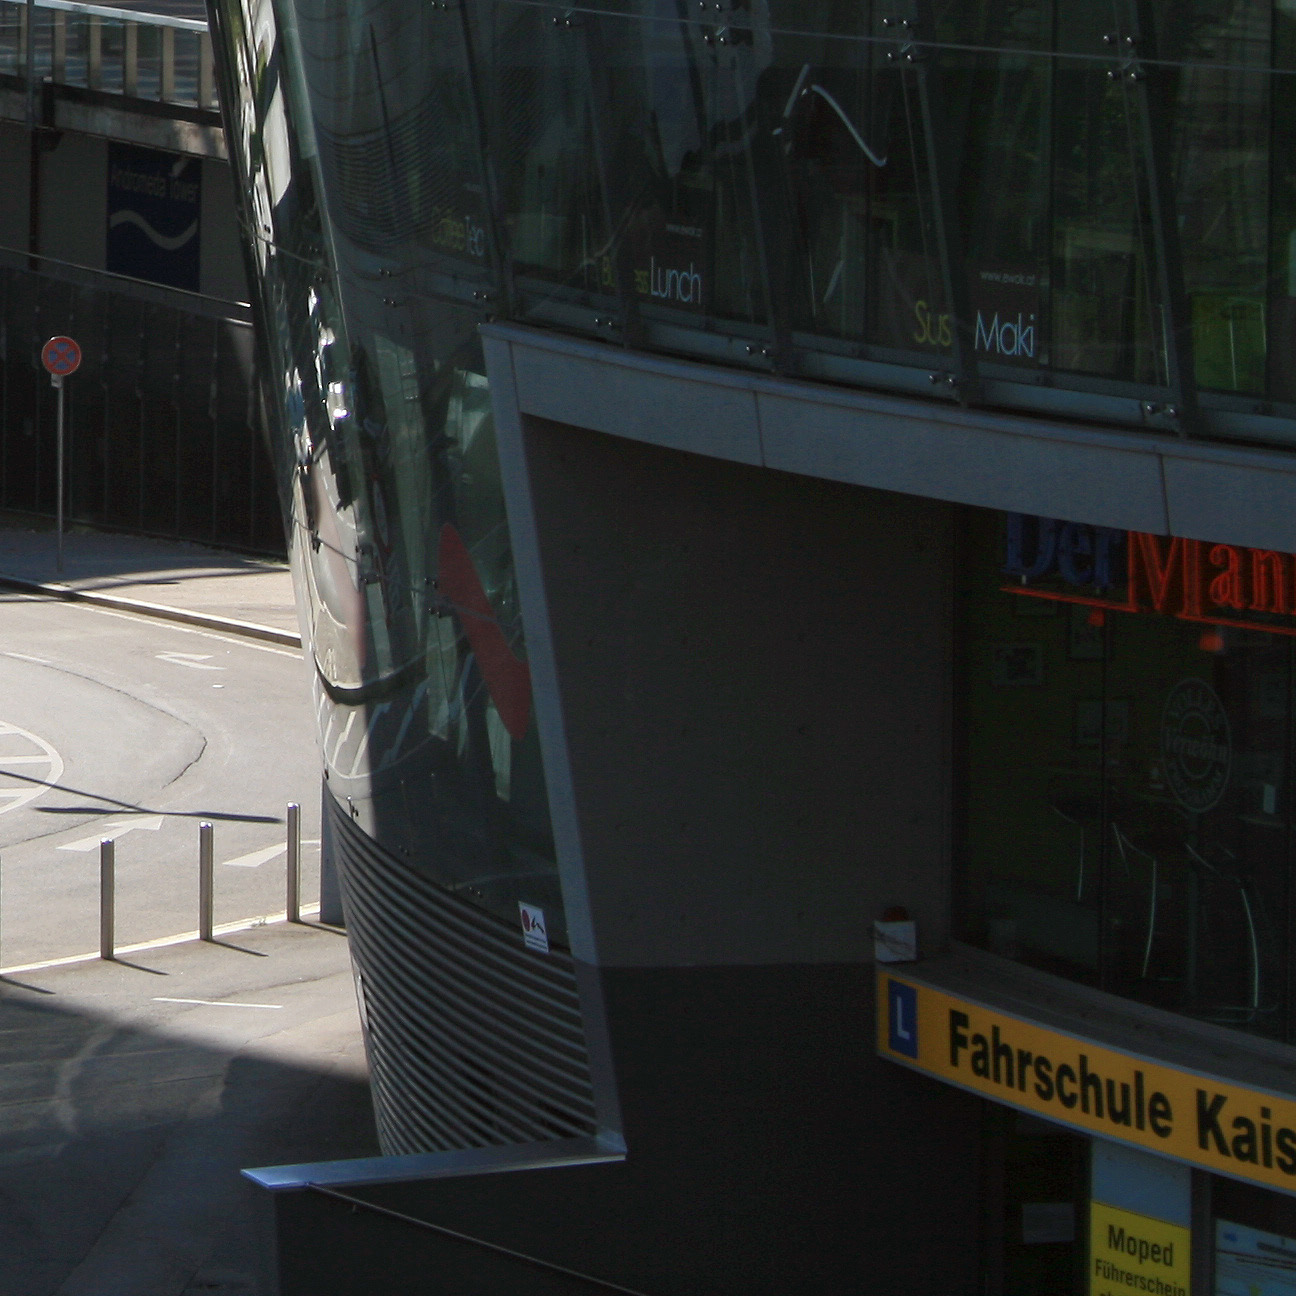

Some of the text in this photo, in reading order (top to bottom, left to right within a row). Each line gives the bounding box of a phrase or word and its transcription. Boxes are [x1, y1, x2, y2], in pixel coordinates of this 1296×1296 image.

[650, 255, 701, 305] Lunch
[974, 309, 1035, 358] Maki
[1128, 530, 1296, 618] Man
[896, 995, 911, 1040] L
[949, 1009, 1173, 1137] Fahrschule
[1107, 1224, 1174, 1267] Moped
